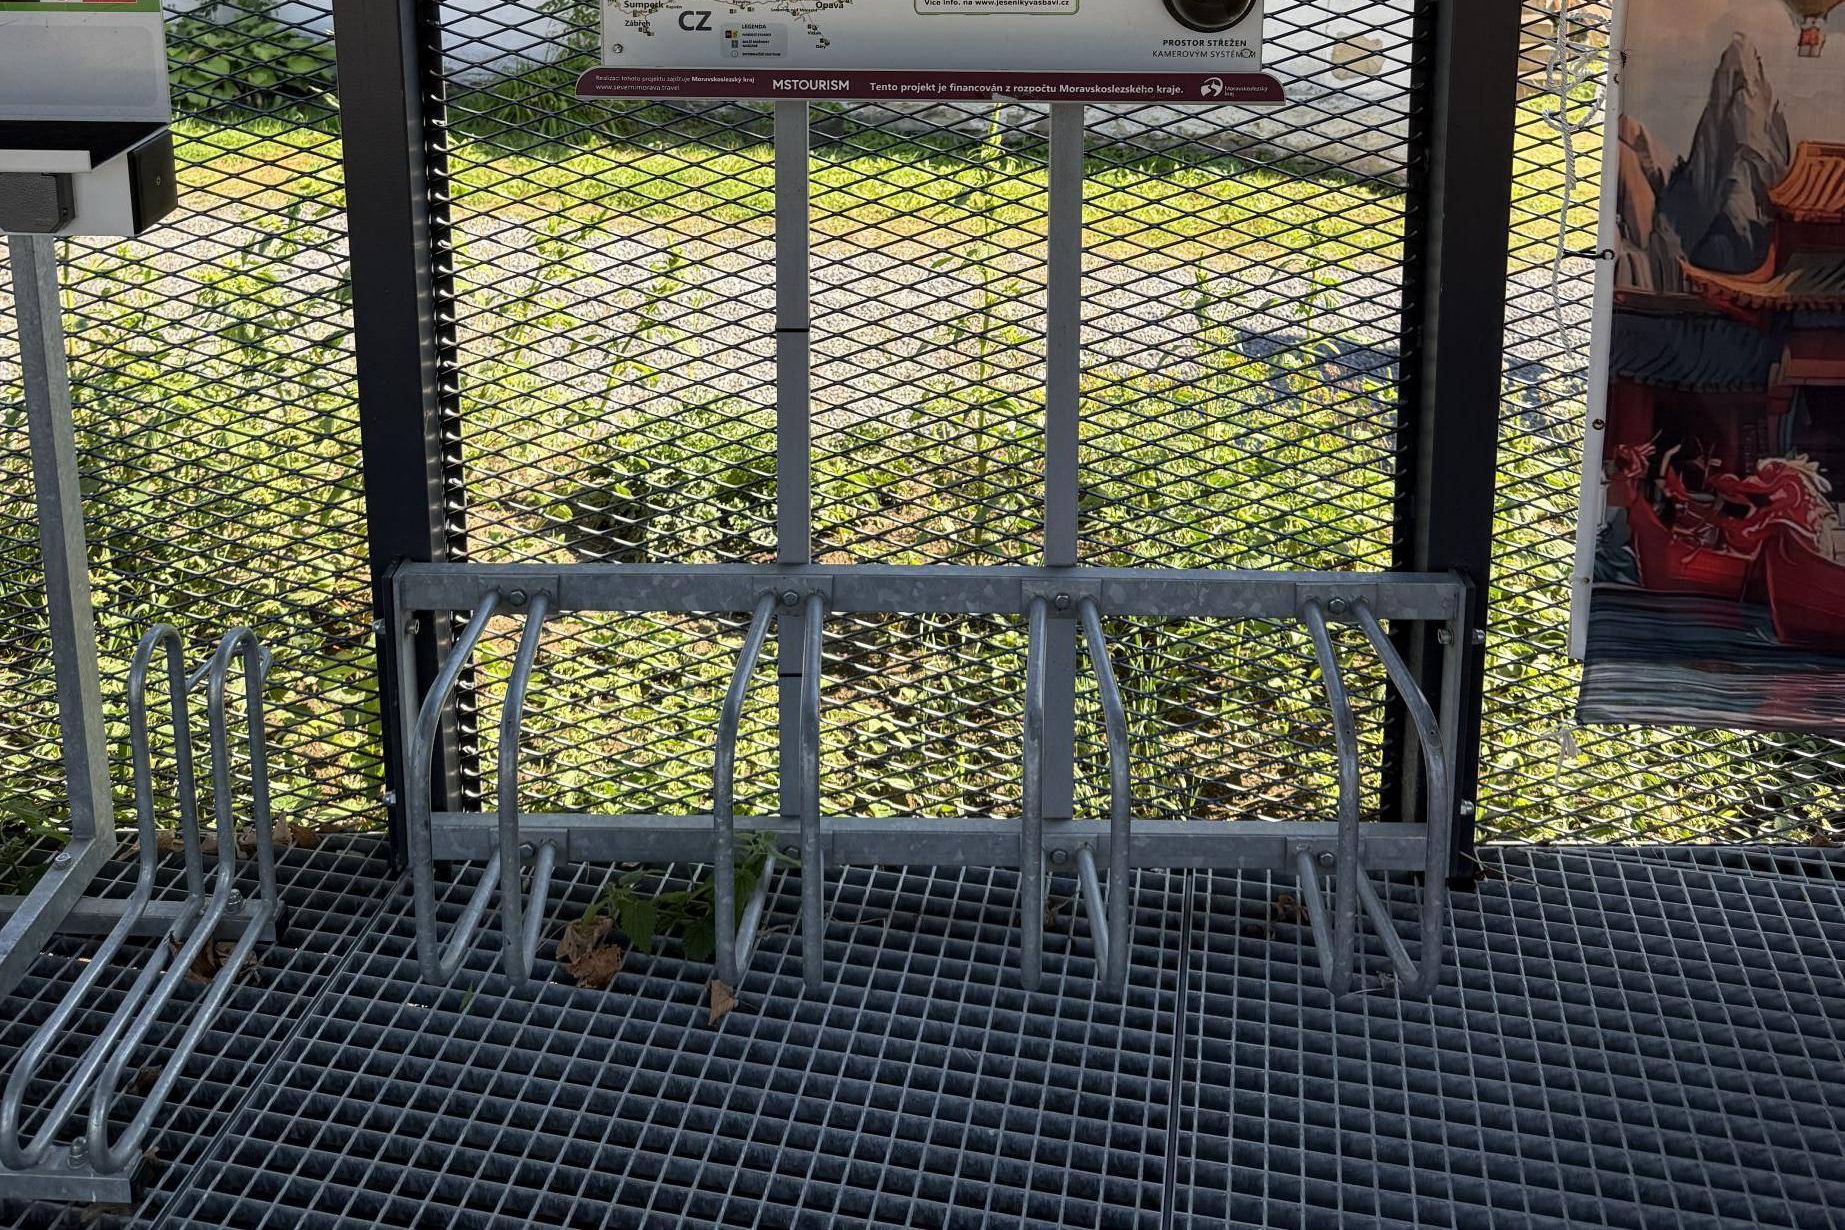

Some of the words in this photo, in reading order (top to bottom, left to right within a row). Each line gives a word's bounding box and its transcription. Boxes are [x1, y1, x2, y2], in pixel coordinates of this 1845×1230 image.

[816, 1, 844, 10] Opava
[678, 10, 712, 31] CZ
[1207, 38, 1247, 47] STŘEŽEN
[1152, 50, 1208, 58] KAMEROVÝM
[772, 79, 850, 91] MSTOURISM
[870, 82, 898, 91] Tento
[901, 82, 936, 93] projekt
[937, 83, 947, 93] je
[950, 82, 1003, 92] financován
[1013, 84, 1056, 94] rozpočtu
[1059, 84, 1153, 94] Moravskoslezského
[1156, 84, 1184, 95] kraje.
